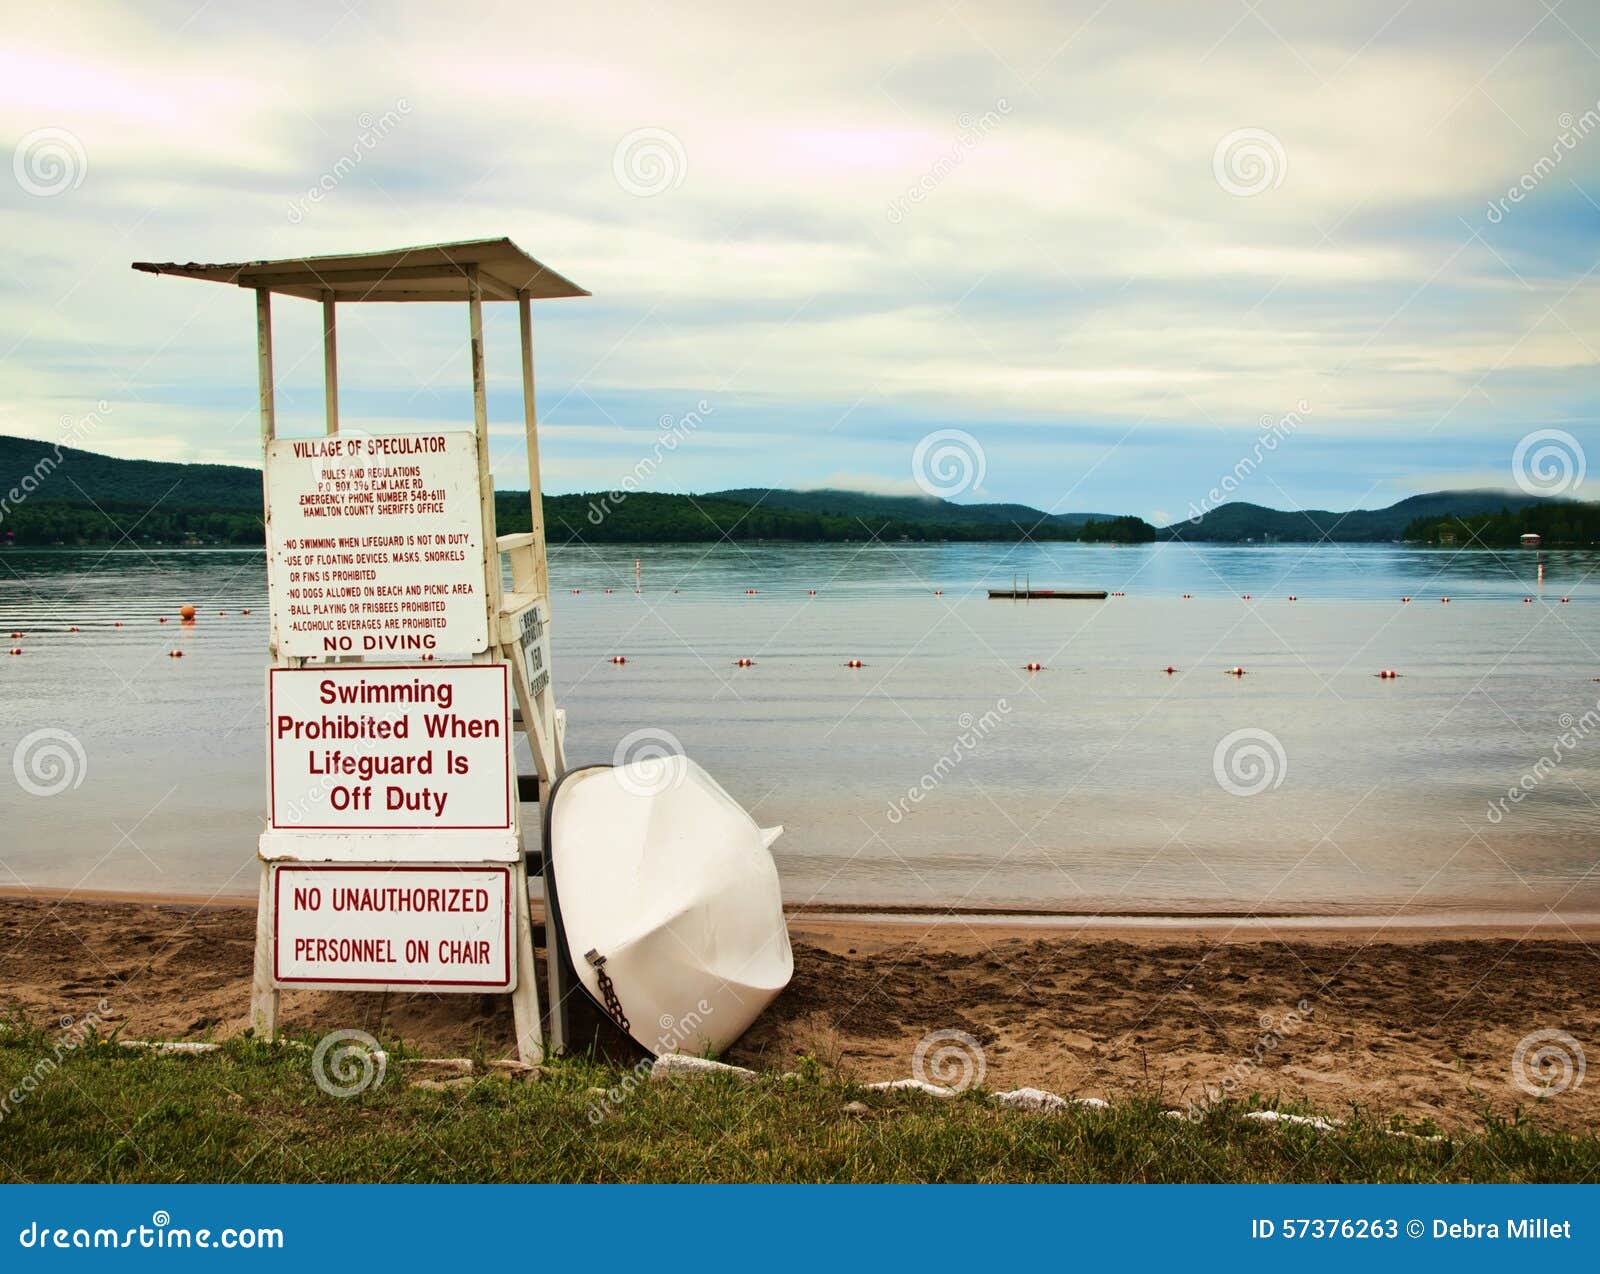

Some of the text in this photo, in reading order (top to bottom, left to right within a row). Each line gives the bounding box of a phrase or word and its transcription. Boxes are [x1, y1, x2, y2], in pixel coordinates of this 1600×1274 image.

[293, 437, 446, 458] VILLAGE OF SPECULATOR
[322, 466, 420, 479] RULES AND REGULATIONS
[336, 481, 350, 491] BOX
[354, 481, 368, 491] 396
[372, 480, 387, 490] ELM
[390, 479, 410, 489] LAKE
[413, 478, 423, 489] RD
[300, 490, 446, 505] EMERGENCY PHONE NUMBER 548-6111
[303, 503, 444, 517] HAMILTON COUNTY SHERIFFS OFFICE
[300, 538, 336, 549] SWIMMING
[338, 537, 360, 548] WHEN
[362, 536, 404, 547] LIFEGUARD
[407, 535, 414, 546] IS
[417, 535, 432, 545] NOT
[435, 534, 446, 545] ON
[449, 534, 469, 544] DUTY
[305, 555, 314, 565] OF
[317, 554, 354, 565] FLOATING
[424, 550, 465, 562] SNORKELS
[290, 570, 376, 582] OR FINS IS PROHIBITED
[303, 588, 323, 598] DOGS
[326, 587, 361, 598] ALLOWED
[364, 586, 374, 597] ON
[377, 586, 403, 596] BEACH
[405, 585, 421, 595] AND
[424, 584, 449, 595] PICNIC
[452, 584, 474, 594] AREA
[314, 604, 346, 614] PLAYING
[349, 603, 360, 614] OR
[362, 602, 399, 613] FRISBEES
[401, 601, 446, 612] PROHIBITED
[337, 619, 382, 630] BEVERAGES
[385, 619, 400, 629] ARE
[402, 617, 447, 629] PROHIBITED
[323, 634, 436, 651] NO DIVING
[320, 679, 453, 709] Swimming
[277, 714, 500, 740] Prohibited When
[309, 750, 469, 782] Lifeguard Is
[330, 785, 449, 817] Off Duty
[294, 887, 489, 912] NO UNAUTHORIZED
[295, 938, 490, 965] PERSONNEL ON CHAIR
